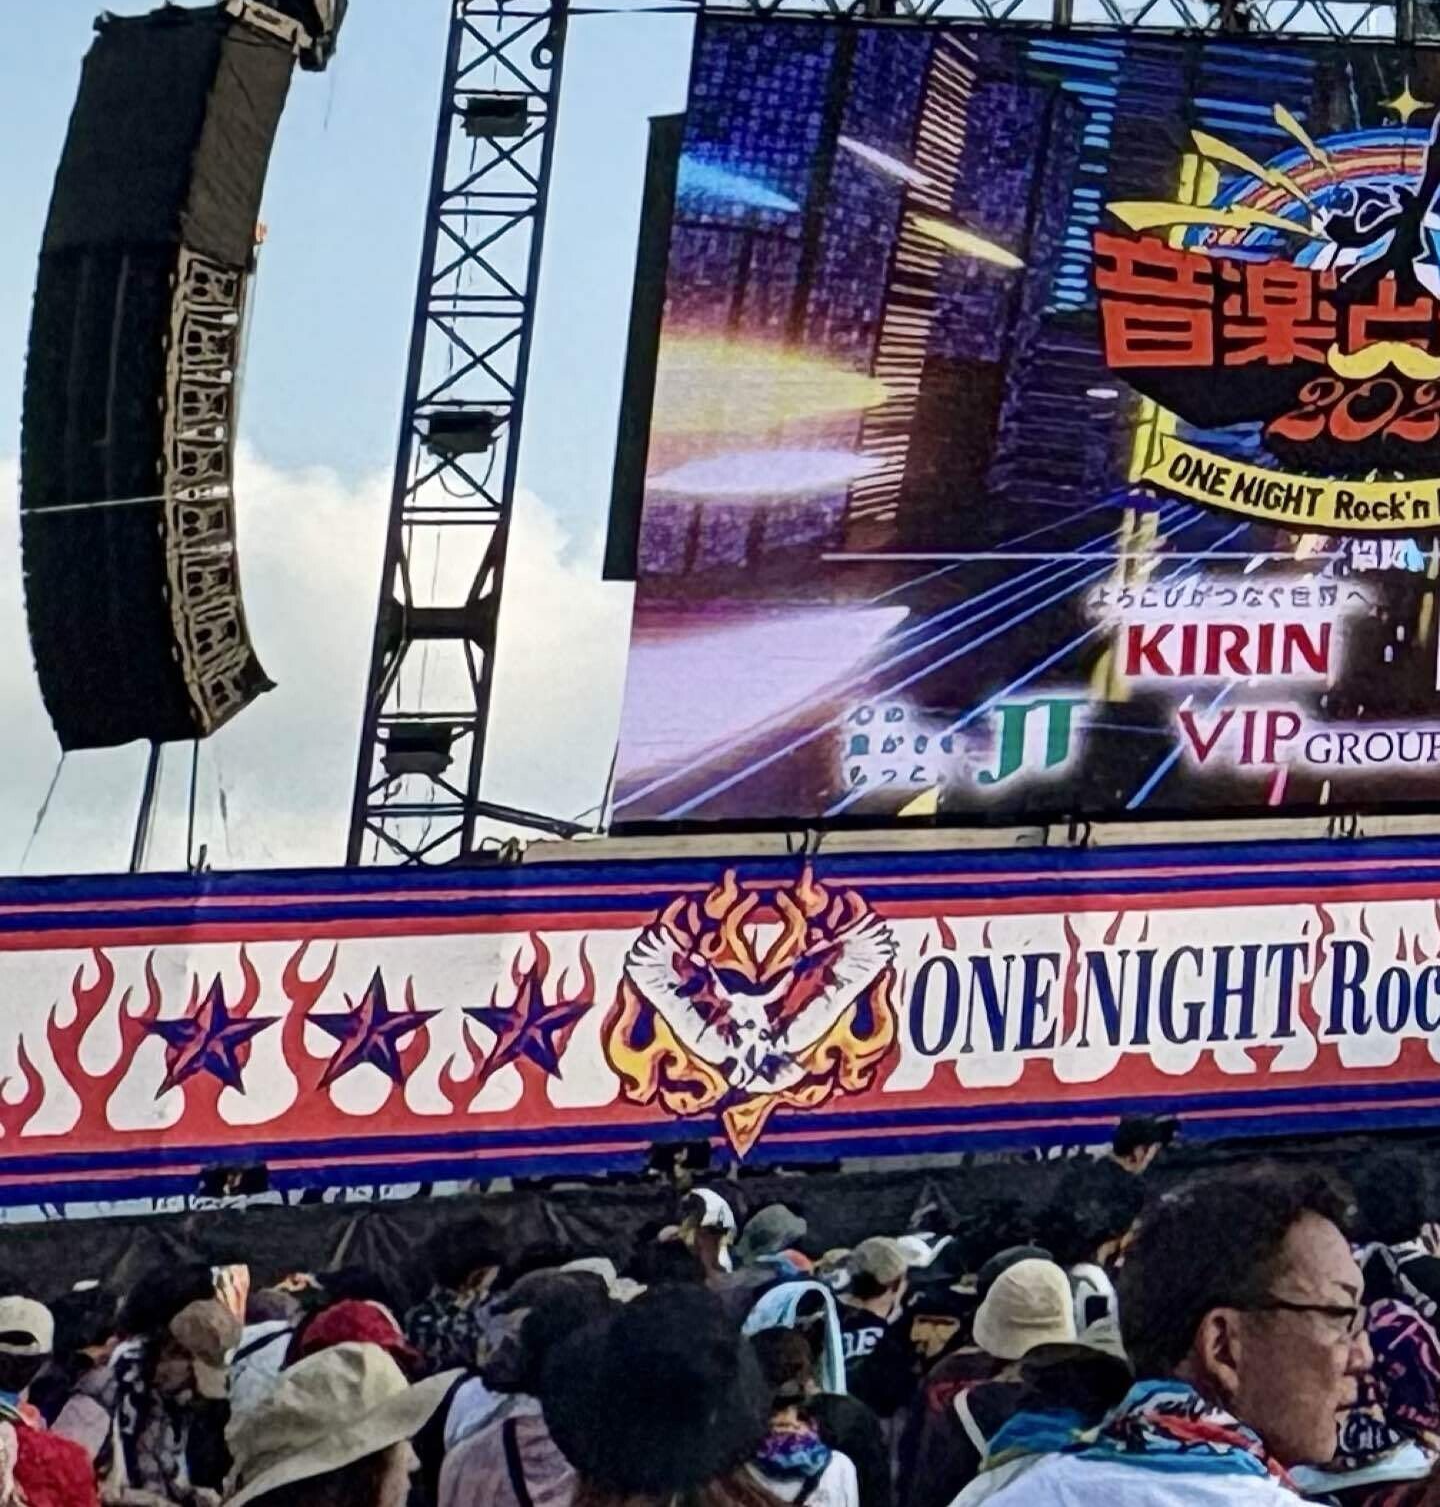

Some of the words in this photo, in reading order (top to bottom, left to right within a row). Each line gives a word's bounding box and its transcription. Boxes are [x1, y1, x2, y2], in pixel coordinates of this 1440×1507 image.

[1167, 451, 1234, 500] ONE
[1235, 469, 1326, 519] NIGHT
[1333, 492, 1431, 522] Rock'n
[1125, 622, 1333, 677] KIRIN
[977, 698, 1091, 785] JT
[1178, 709, 1303, 765] VIP
[906, 951, 1061, 1058] ONE
[1074, 938, 1310, 1049] NIGHT
